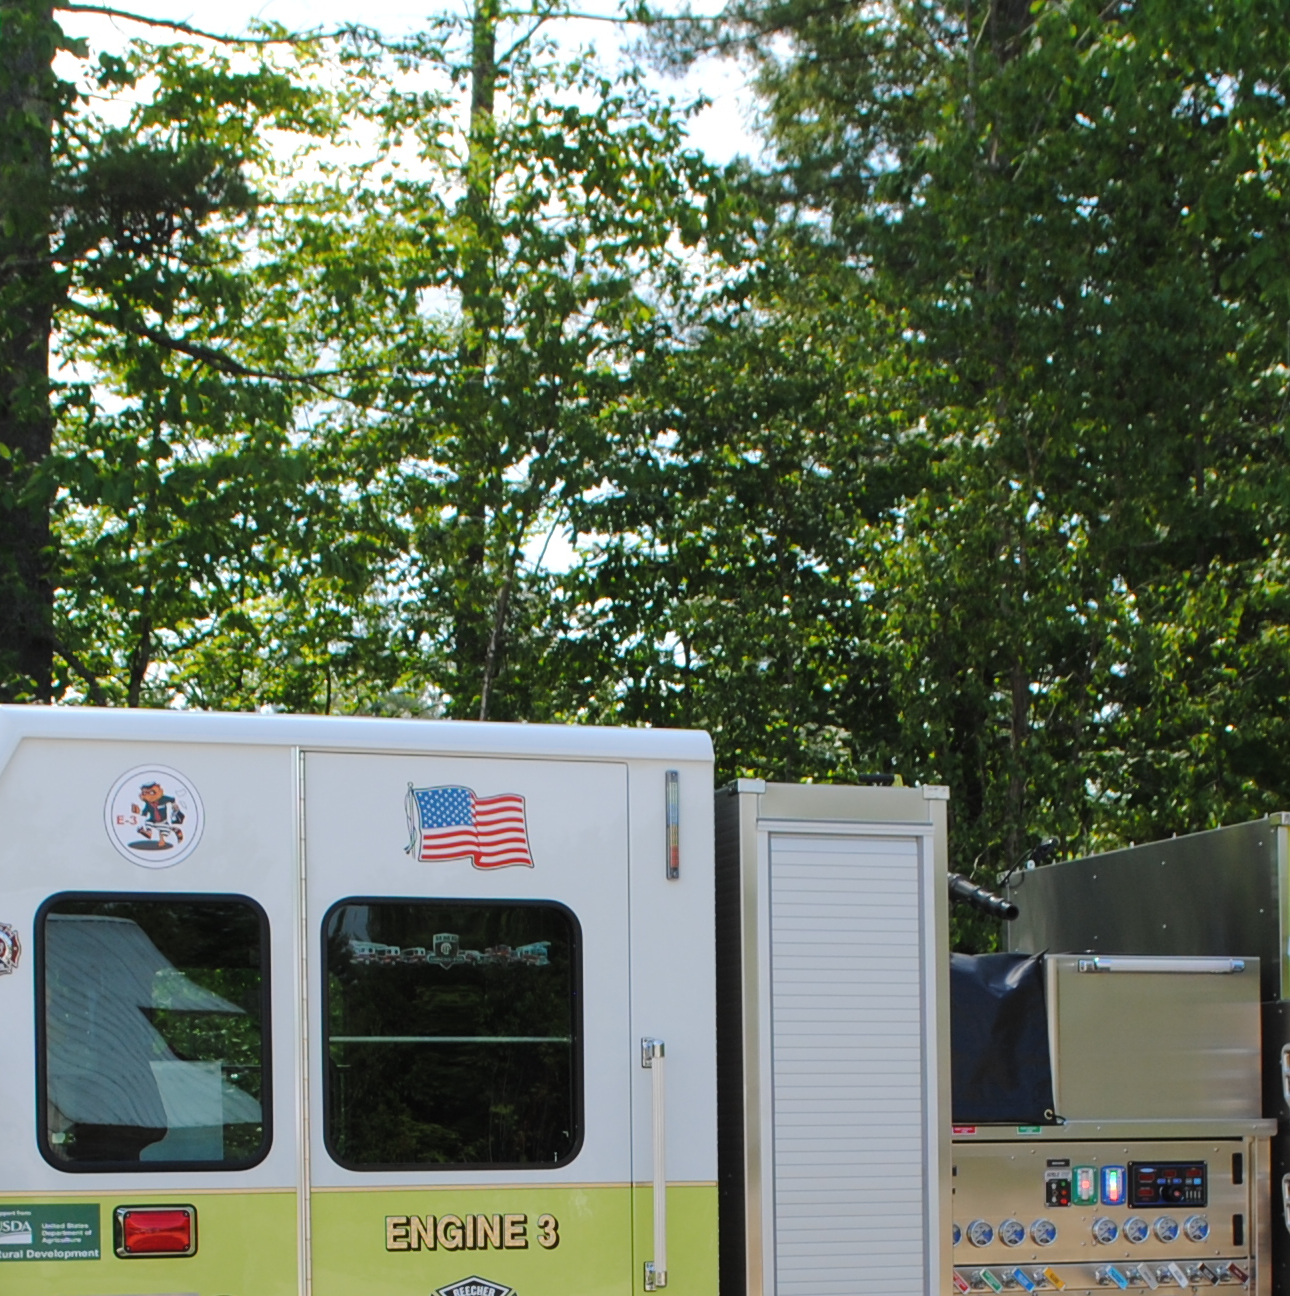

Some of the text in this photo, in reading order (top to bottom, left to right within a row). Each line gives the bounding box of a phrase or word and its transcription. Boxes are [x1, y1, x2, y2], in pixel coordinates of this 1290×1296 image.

[116, 814, 138, 825] E-3
[41, 1230, 83, 1238] Department
[385, 1213, 560, 1252] ENGINE 3
[41, 1237, 82, 1245] Agriculture
[26, 1248, 99, 1260] Development
